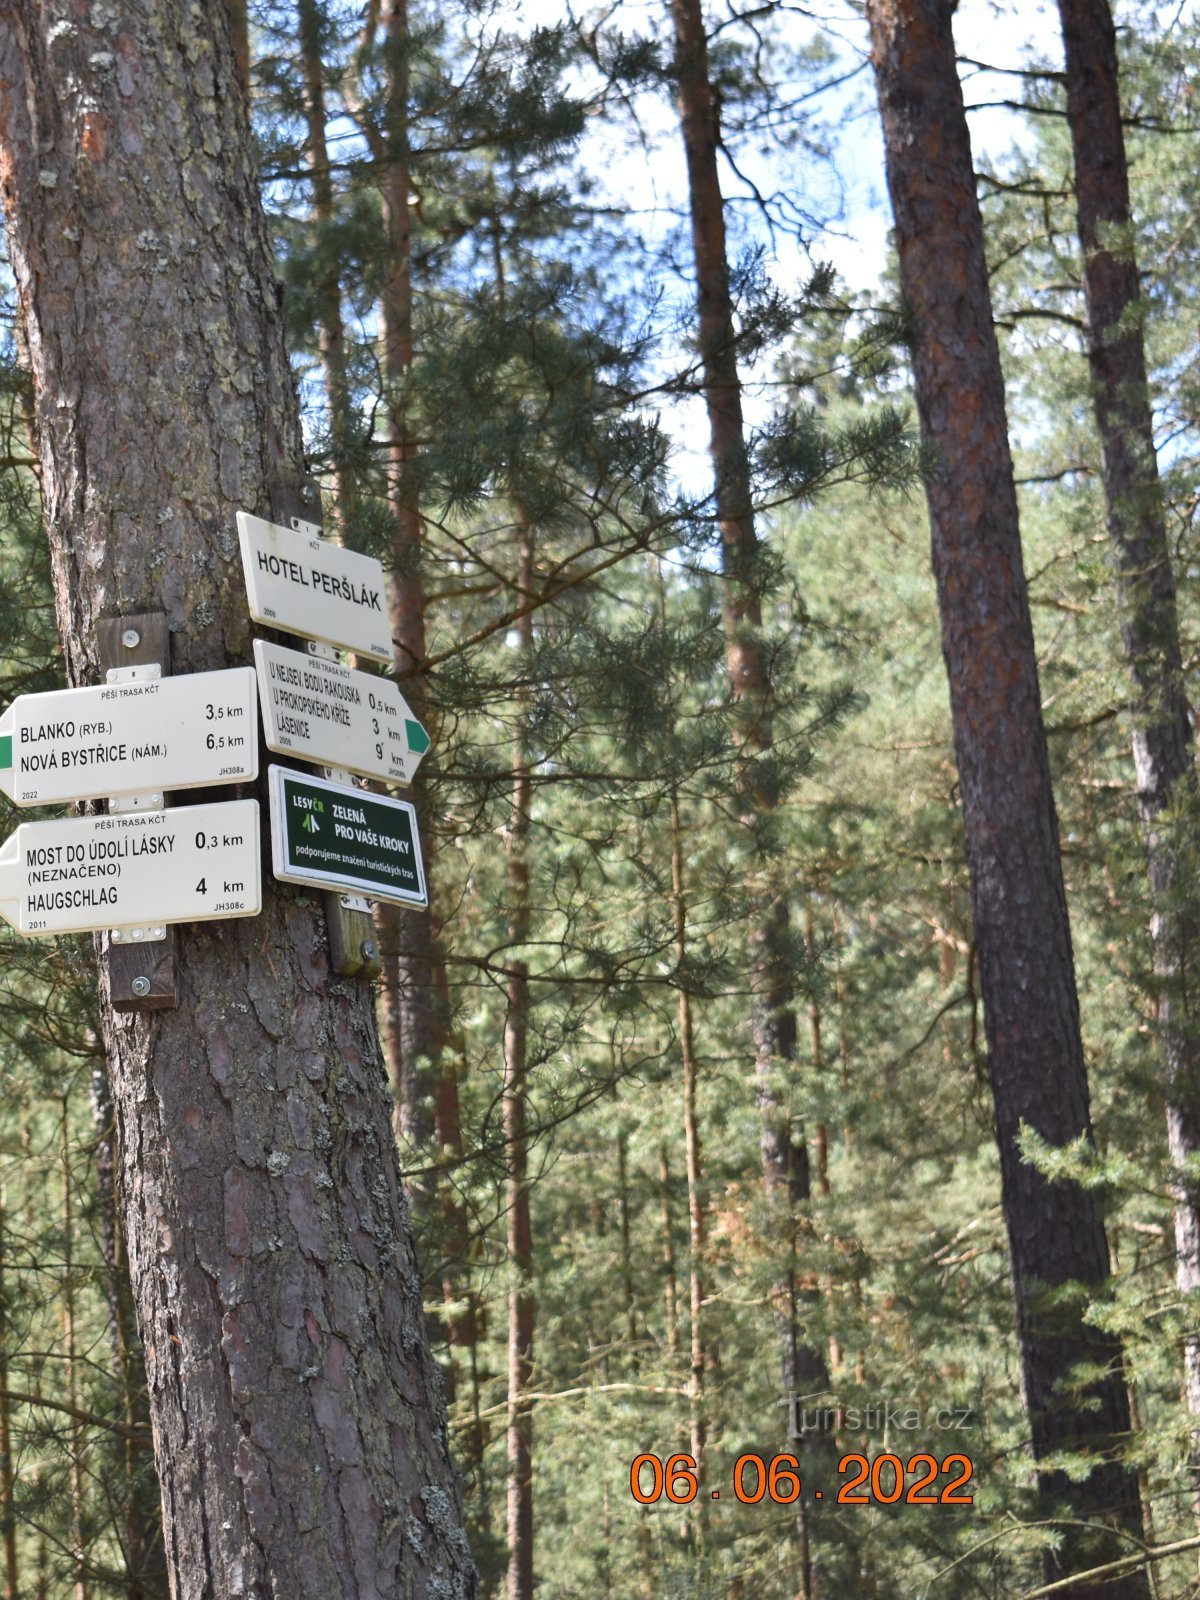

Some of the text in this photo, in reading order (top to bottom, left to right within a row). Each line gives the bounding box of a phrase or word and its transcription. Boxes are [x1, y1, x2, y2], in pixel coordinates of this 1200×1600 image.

[257, 551, 382, 612] HOTEL PERŠLÁK
[321, 663, 338, 676] TRASA
[339, 667, 350, 679] KČT
[101, 685, 159, 700] PĚŠÍ TRASA KČT
[270, 662, 397, 716] U NEJSEV. BODU RAKOUSKA 0,5 km
[21, 704, 243, 743] BLANKO (RYB.) 3,5 km
[273, 688, 400, 741] U PROKOPSKÉHO KŘÍŽE 3 km
[21, 733, 244, 772] NOVÁ BYSTŘICE (NÁM.) 6,5 km
[276, 713, 404, 767] LÁSENICE 9 km
[218, 766, 244, 776] JH308a
[22, 791, 38, 800] 2022
[95, 815, 166, 830] PĚŠÍ TRASA KČT
[332, 804, 366, 825] ZELENÁ
[27, 832, 243, 867] MOST DO ÚDOLÍ LÁSKY 0,3 km
[335, 824, 409, 854] PRO VAŠE KROKY
[28, 862, 121, 886] (NEZNAČENO)
[295, 845, 414, 879] podporujeme značení turistických tras
[28, 878, 244, 912] HAUGSCHLAG 4 km
[214, 902, 245, 912] JH308c
[28, 920, 46, 929] 2011
